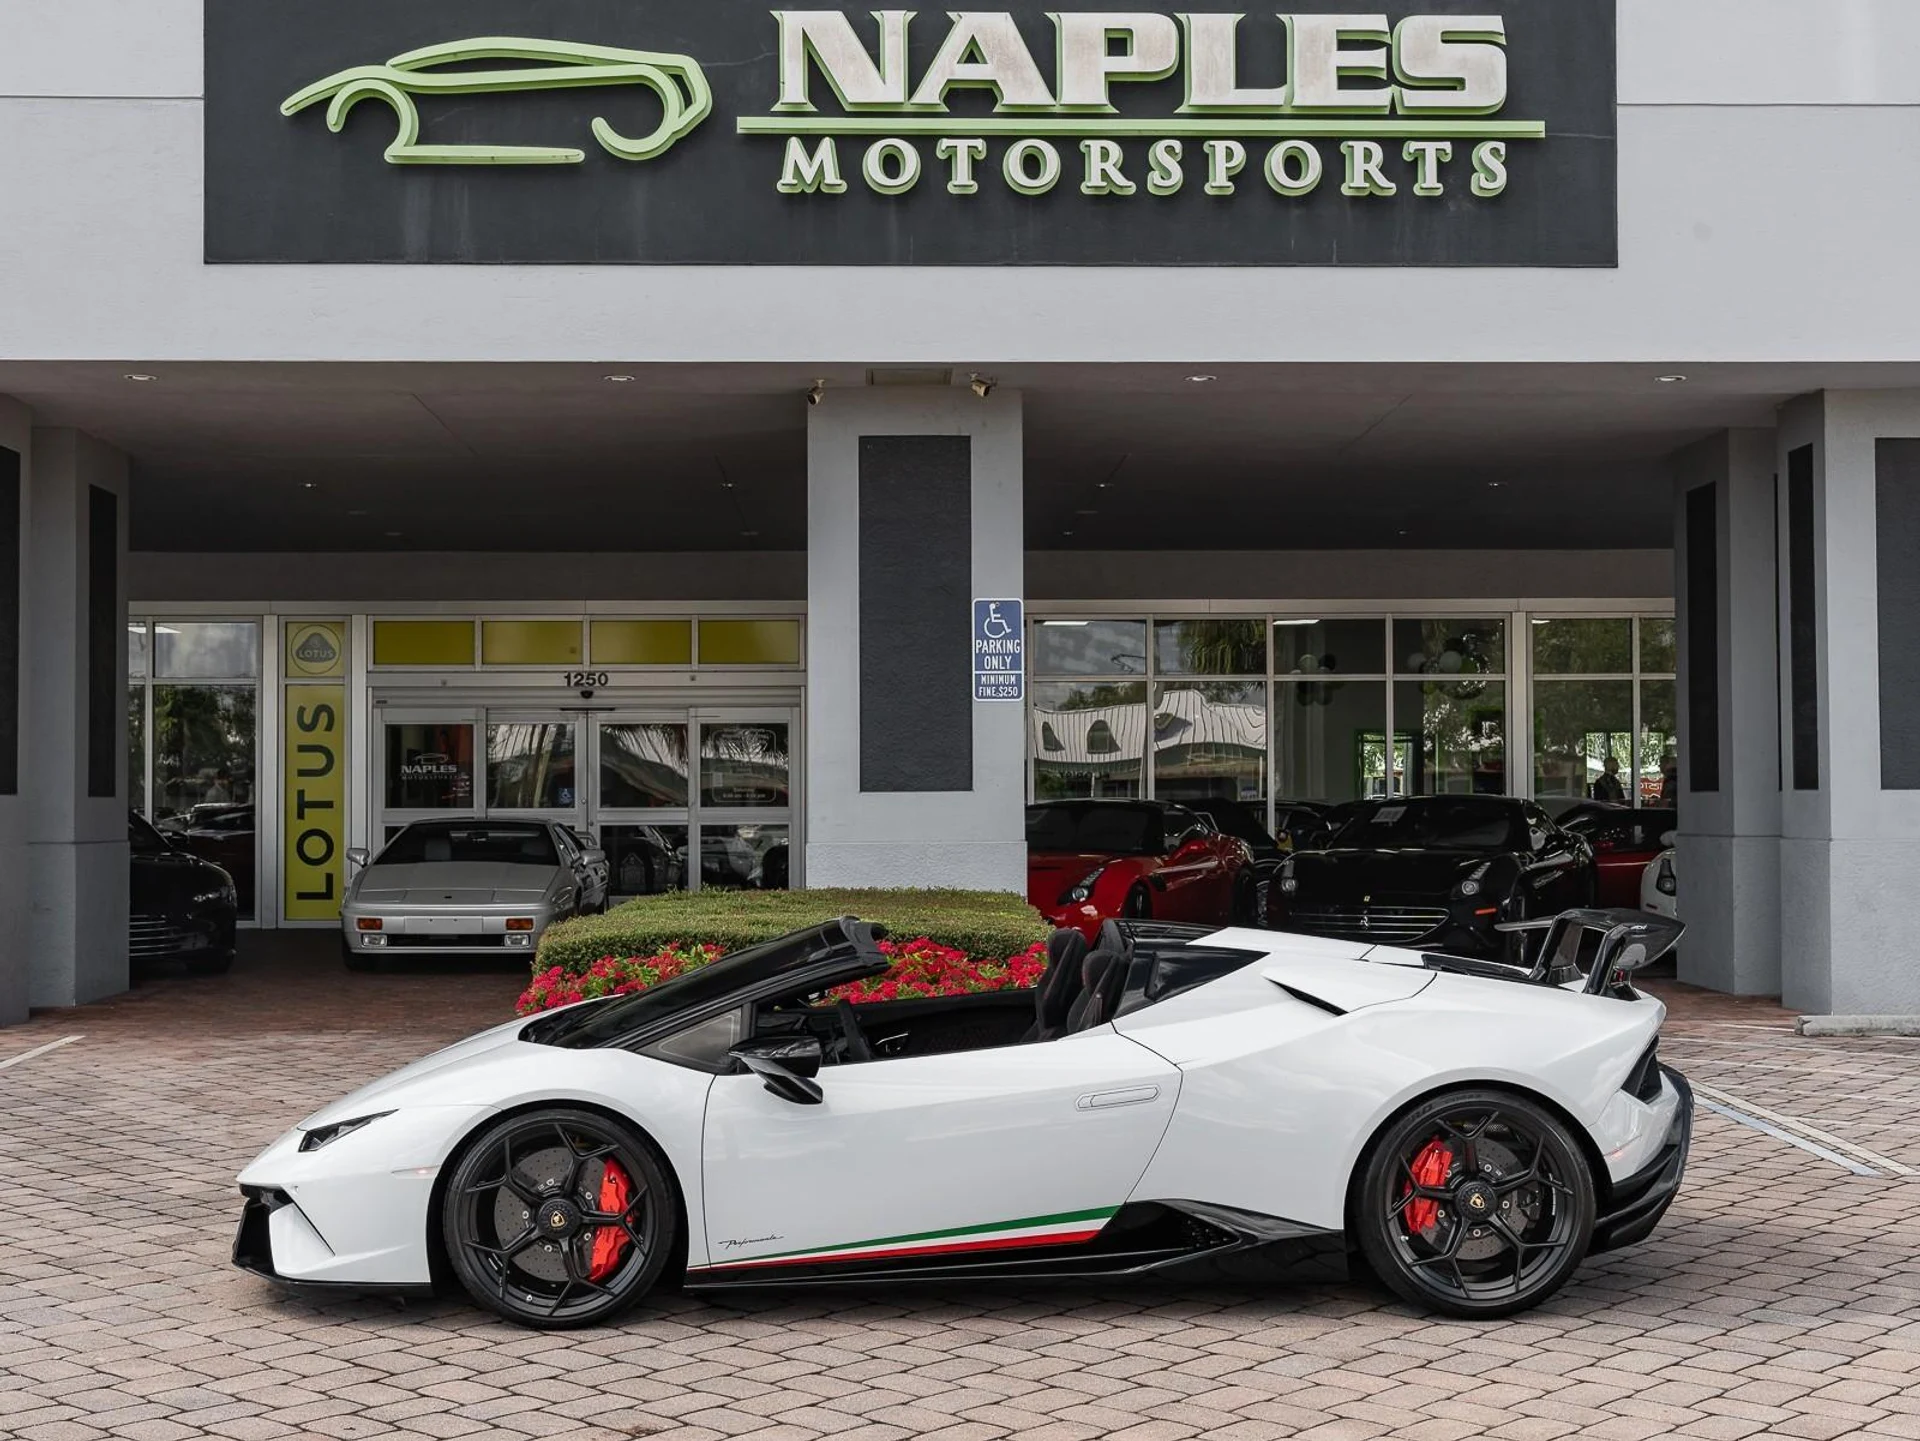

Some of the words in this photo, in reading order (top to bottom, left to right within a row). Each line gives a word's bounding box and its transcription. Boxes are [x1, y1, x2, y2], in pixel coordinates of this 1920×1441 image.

[771, 10, 1507, 115] NAPLES
[776, 137, 1508, 197] MOTORSPORTS
[975, 639, 1020, 653] PARKING
[299, 649, 334, 658] LOTUS
[984, 655, 1012, 669] ONLY
[563, 672, 609, 688] 1250
[981, 674, 1016, 685] MINIMUM
[979, 686, 996, 697] FINE
[998, 686, 1018, 697] $250
[402, 764, 457, 773] NAPLES
[296, 703, 335, 900] LOTUS
